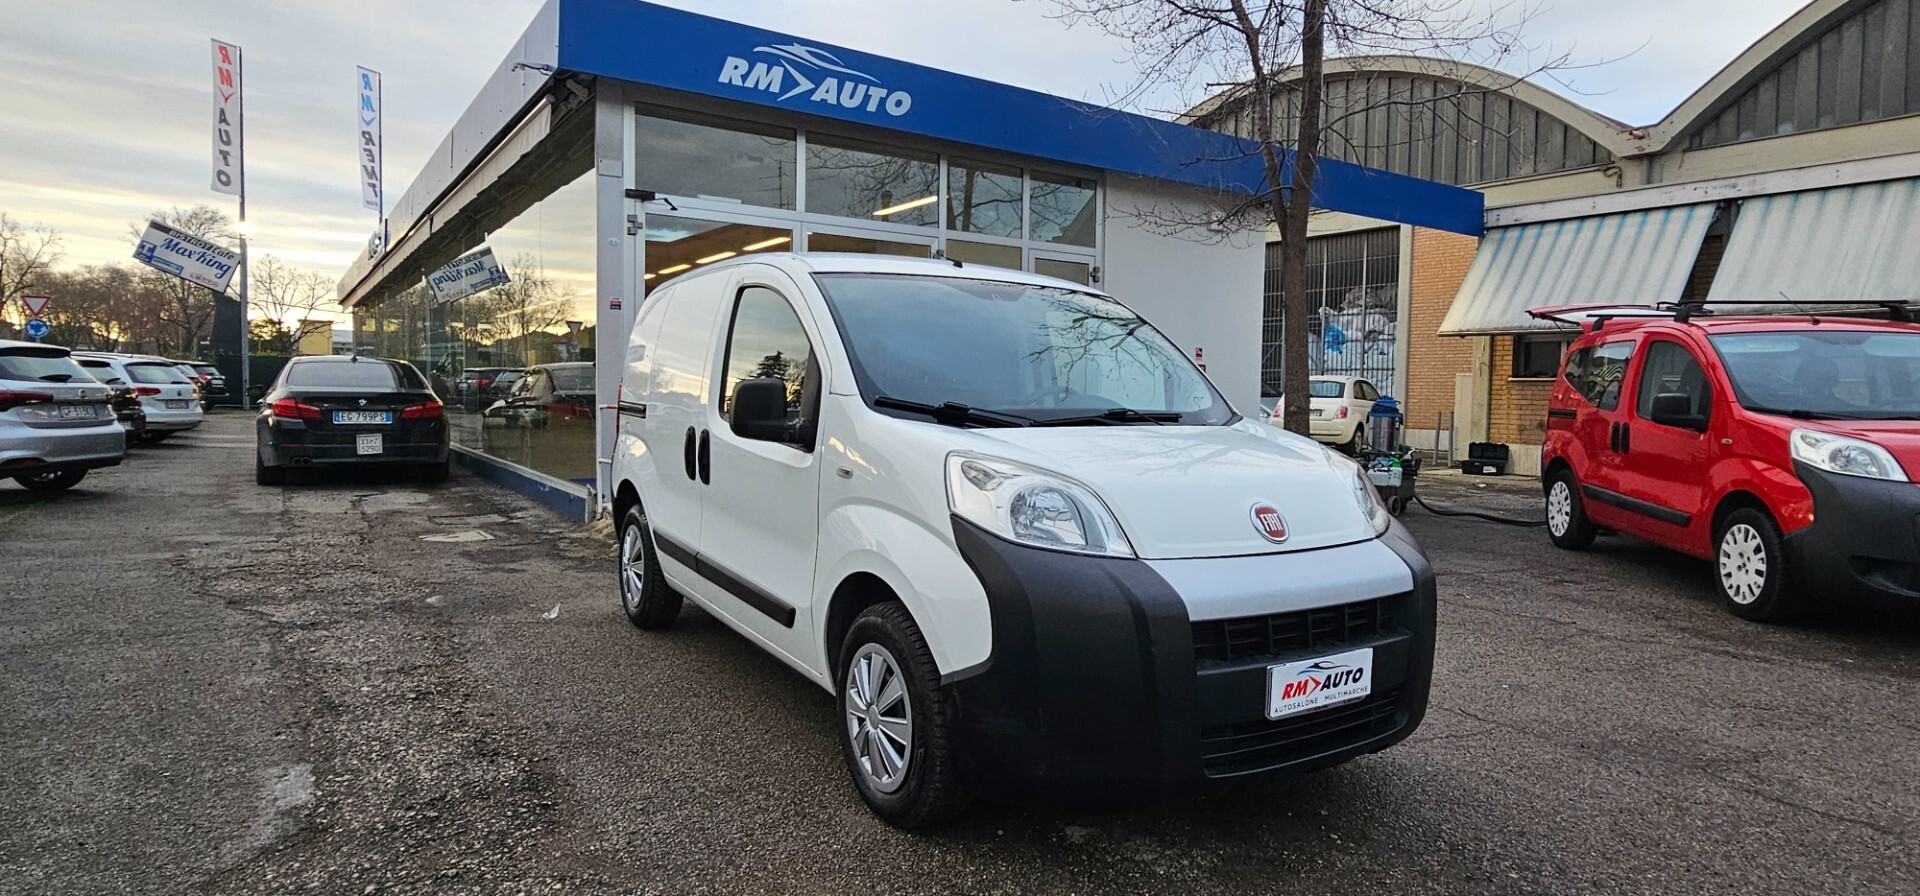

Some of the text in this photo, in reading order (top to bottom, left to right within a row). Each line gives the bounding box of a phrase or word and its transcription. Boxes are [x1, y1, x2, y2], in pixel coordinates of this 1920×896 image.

[718, 56, 912, 116] RM AUTO
[356, 411, 385, 421] 799PS
[1259, 513, 1284, 532] FIAT
[1281, 667, 1364, 700] RM AUTO
[1274, 685, 1369, 714] AUTOSALONE MULTIMARCHE
